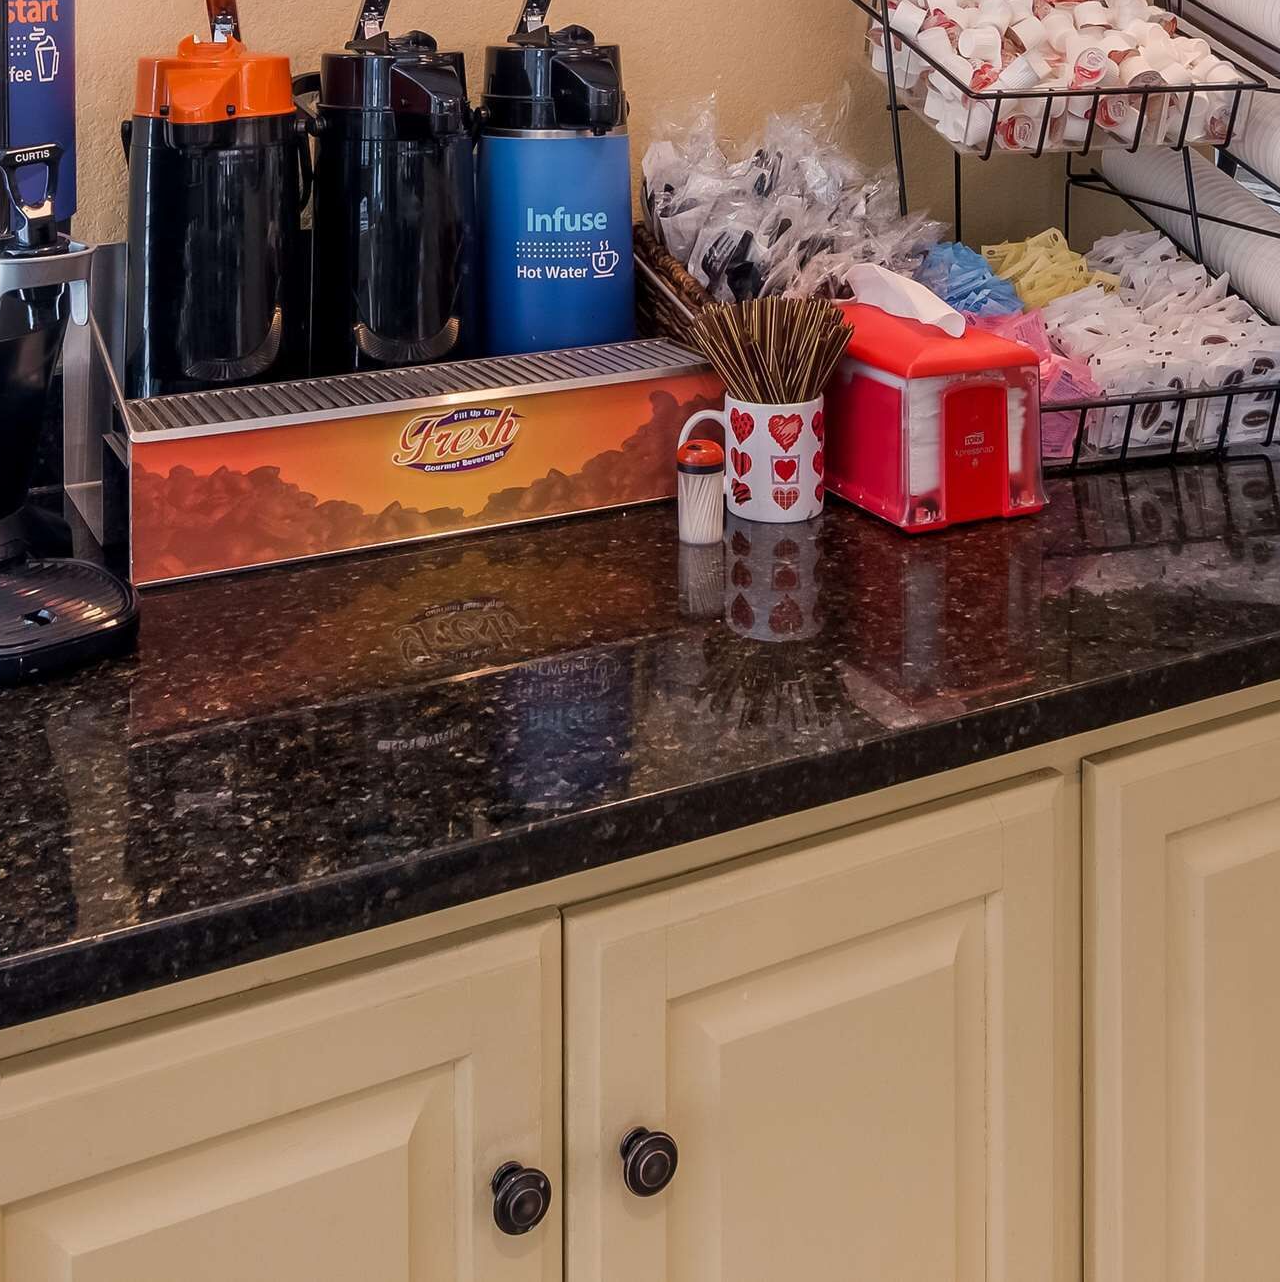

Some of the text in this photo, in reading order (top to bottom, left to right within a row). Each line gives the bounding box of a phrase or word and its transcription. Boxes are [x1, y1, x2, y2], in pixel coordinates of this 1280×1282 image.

[15, 149, 50, 163] CURTIS
[527, 206, 608, 232] Infuse
[517, 265, 589, 279] Hot Water
[453, 408, 495, 421] Fill Up On
[392, 405, 520, 466] Fresh
[424, 450, 505, 472] Gourmet Beverages
